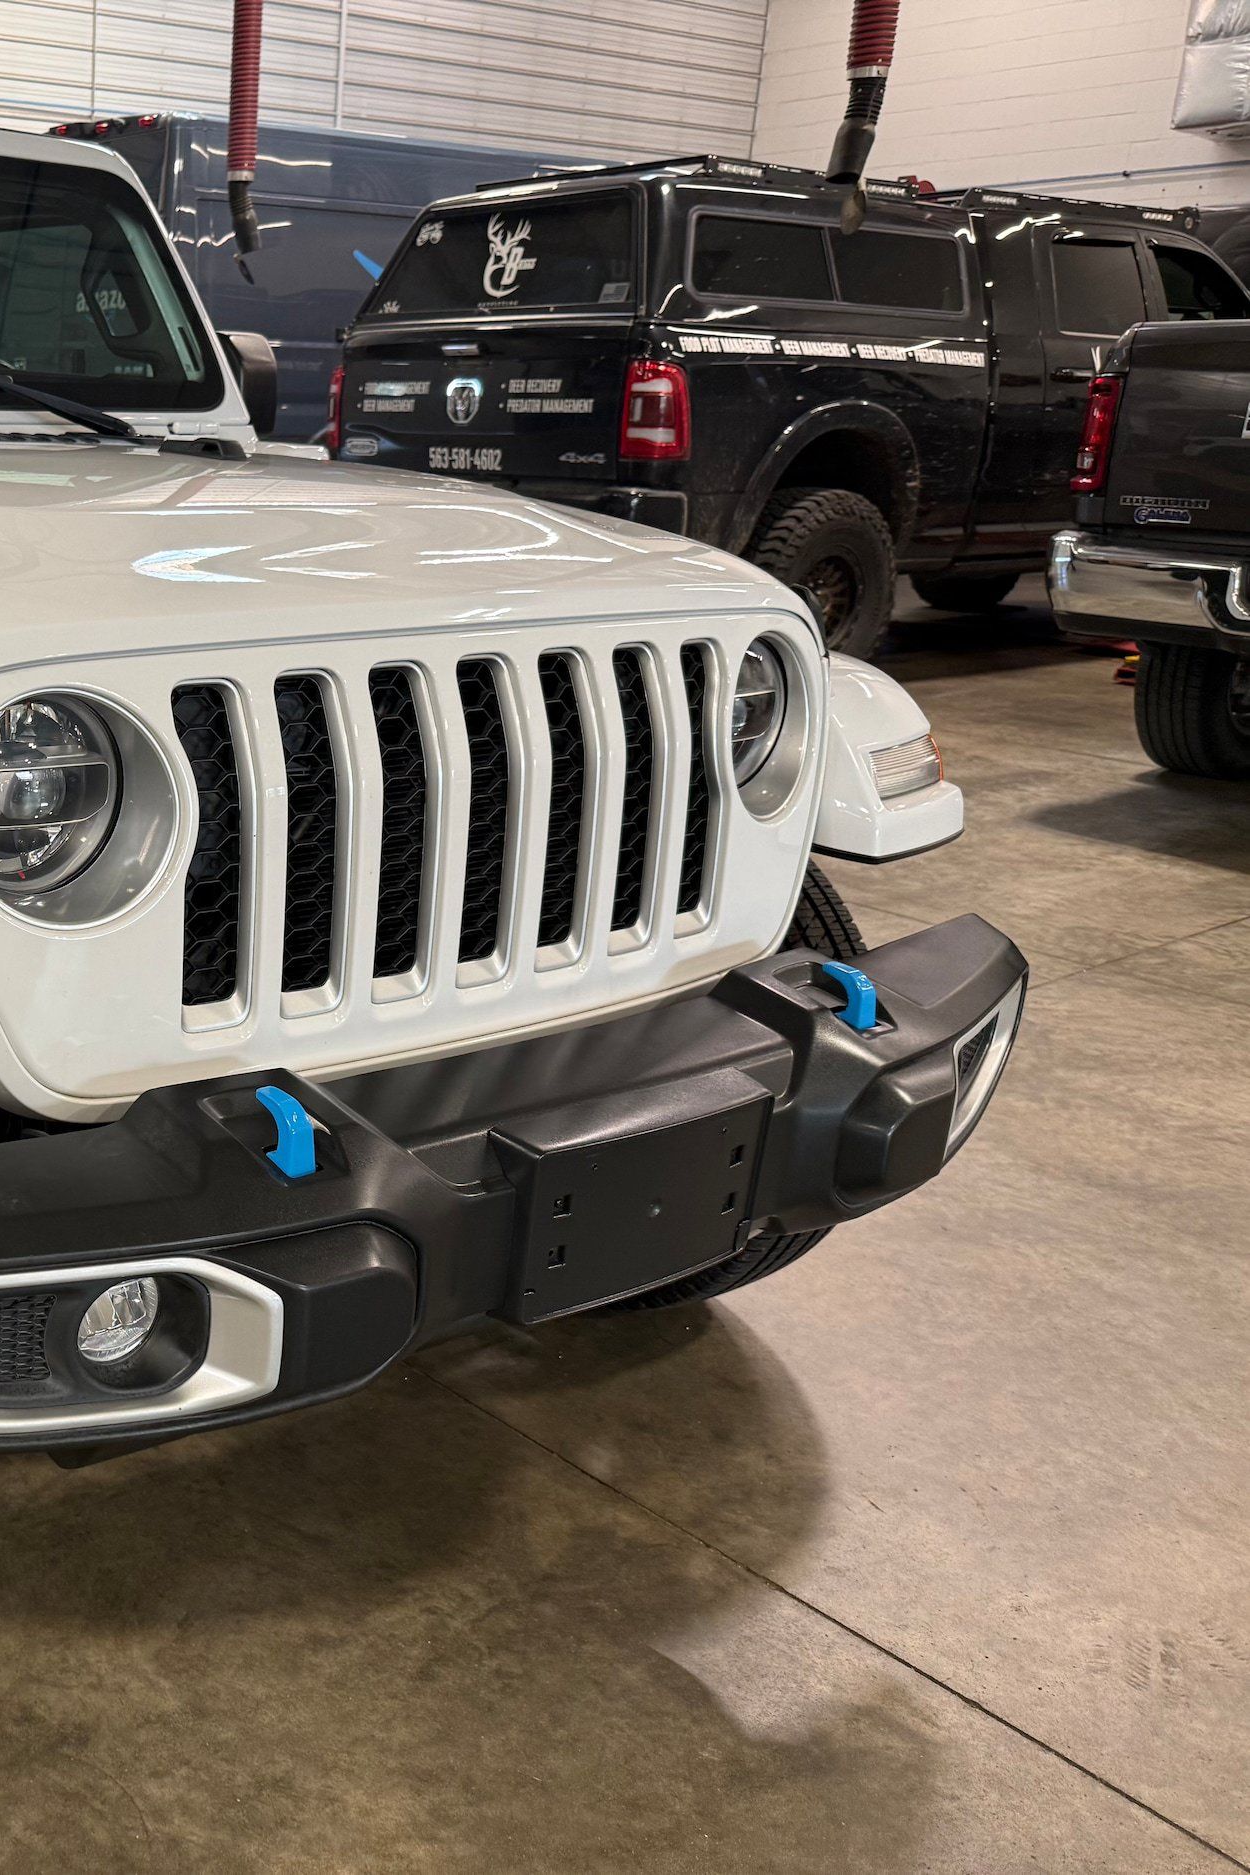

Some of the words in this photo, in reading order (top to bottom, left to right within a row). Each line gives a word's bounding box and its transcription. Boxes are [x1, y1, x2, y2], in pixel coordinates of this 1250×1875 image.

[678, 336, 702, 352] FOOD
[701, 337, 722, 353] PLOT
[720, 338, 774, 354] MANAGEMENT
[780, 339, 802, 355] DEER
[800, 341, 851, 358] MANAGEMENT
[857, 344, 876, 359] DEER
[914, 348, 945, 364] PREDATOR
[944, 350, 986, 367] MANAGEMENT
[508, 379, 526, 393] DEER
[526, 379, 563, 393] RECOVERY
[363, 399, 376, 413] DEER
[376, 399, 415, 413] MANAGEMENT
[507, 399, 541, 413] PREDATOR
[541, 399, 595, 413] MANAGEMENT
[429, 446, 502, 471] 563-581-4602
